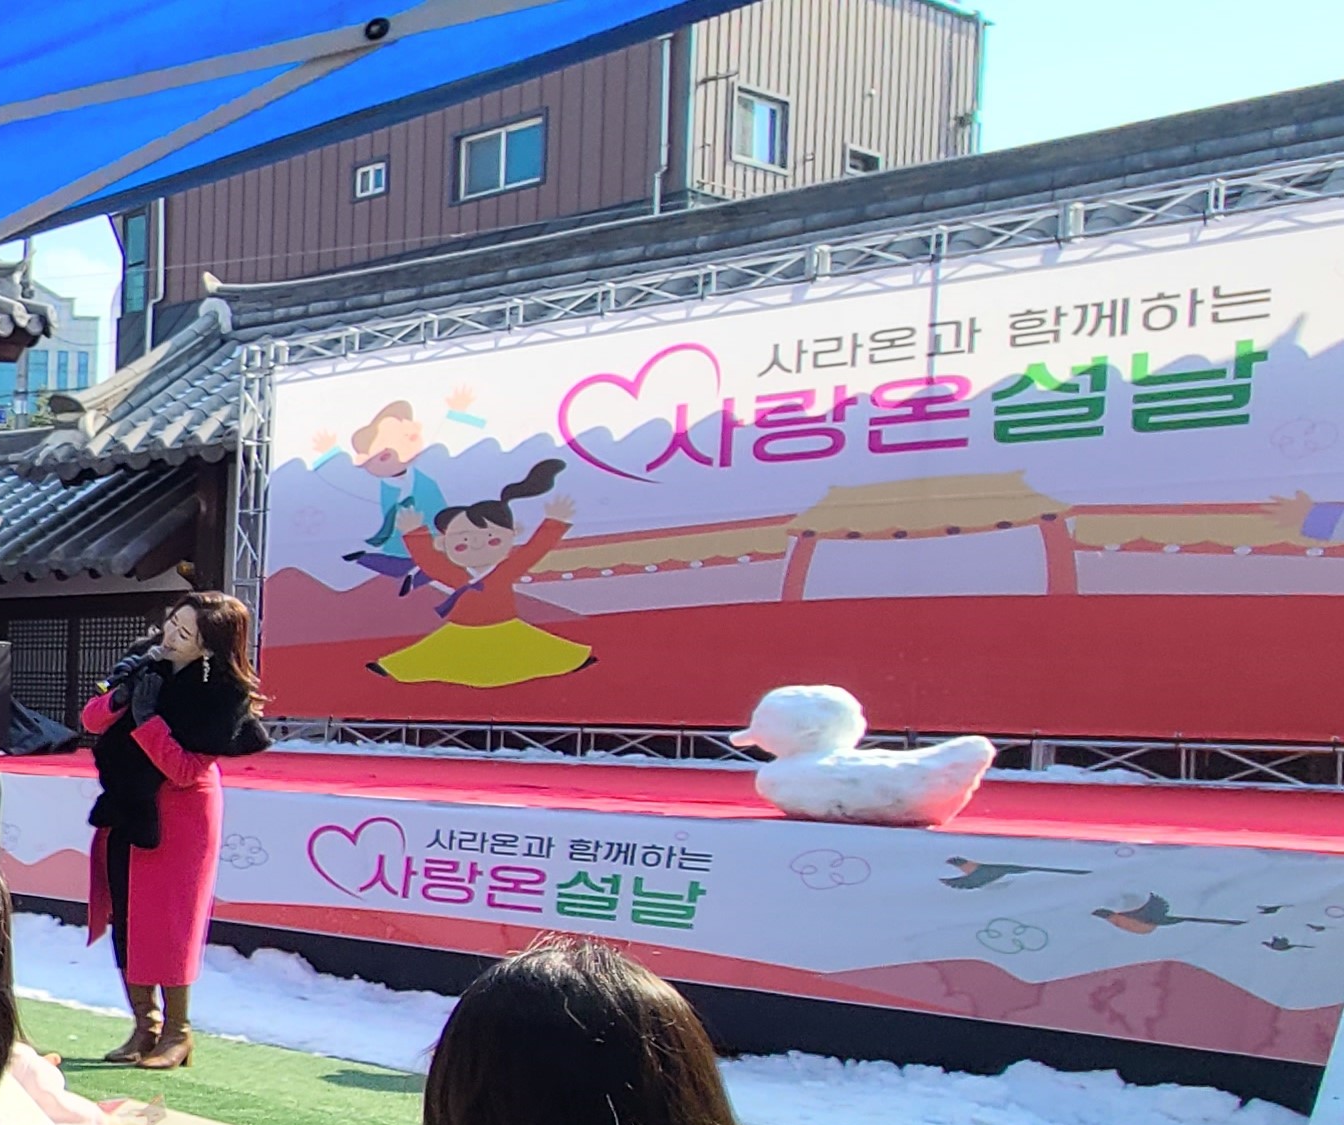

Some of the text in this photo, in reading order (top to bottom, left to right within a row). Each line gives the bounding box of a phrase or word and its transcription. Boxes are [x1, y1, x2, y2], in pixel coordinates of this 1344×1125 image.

[757, 286, 1272, 378] 사라온과 함께하는
[425, 828, 713, 873] 사라온과 함께하는
